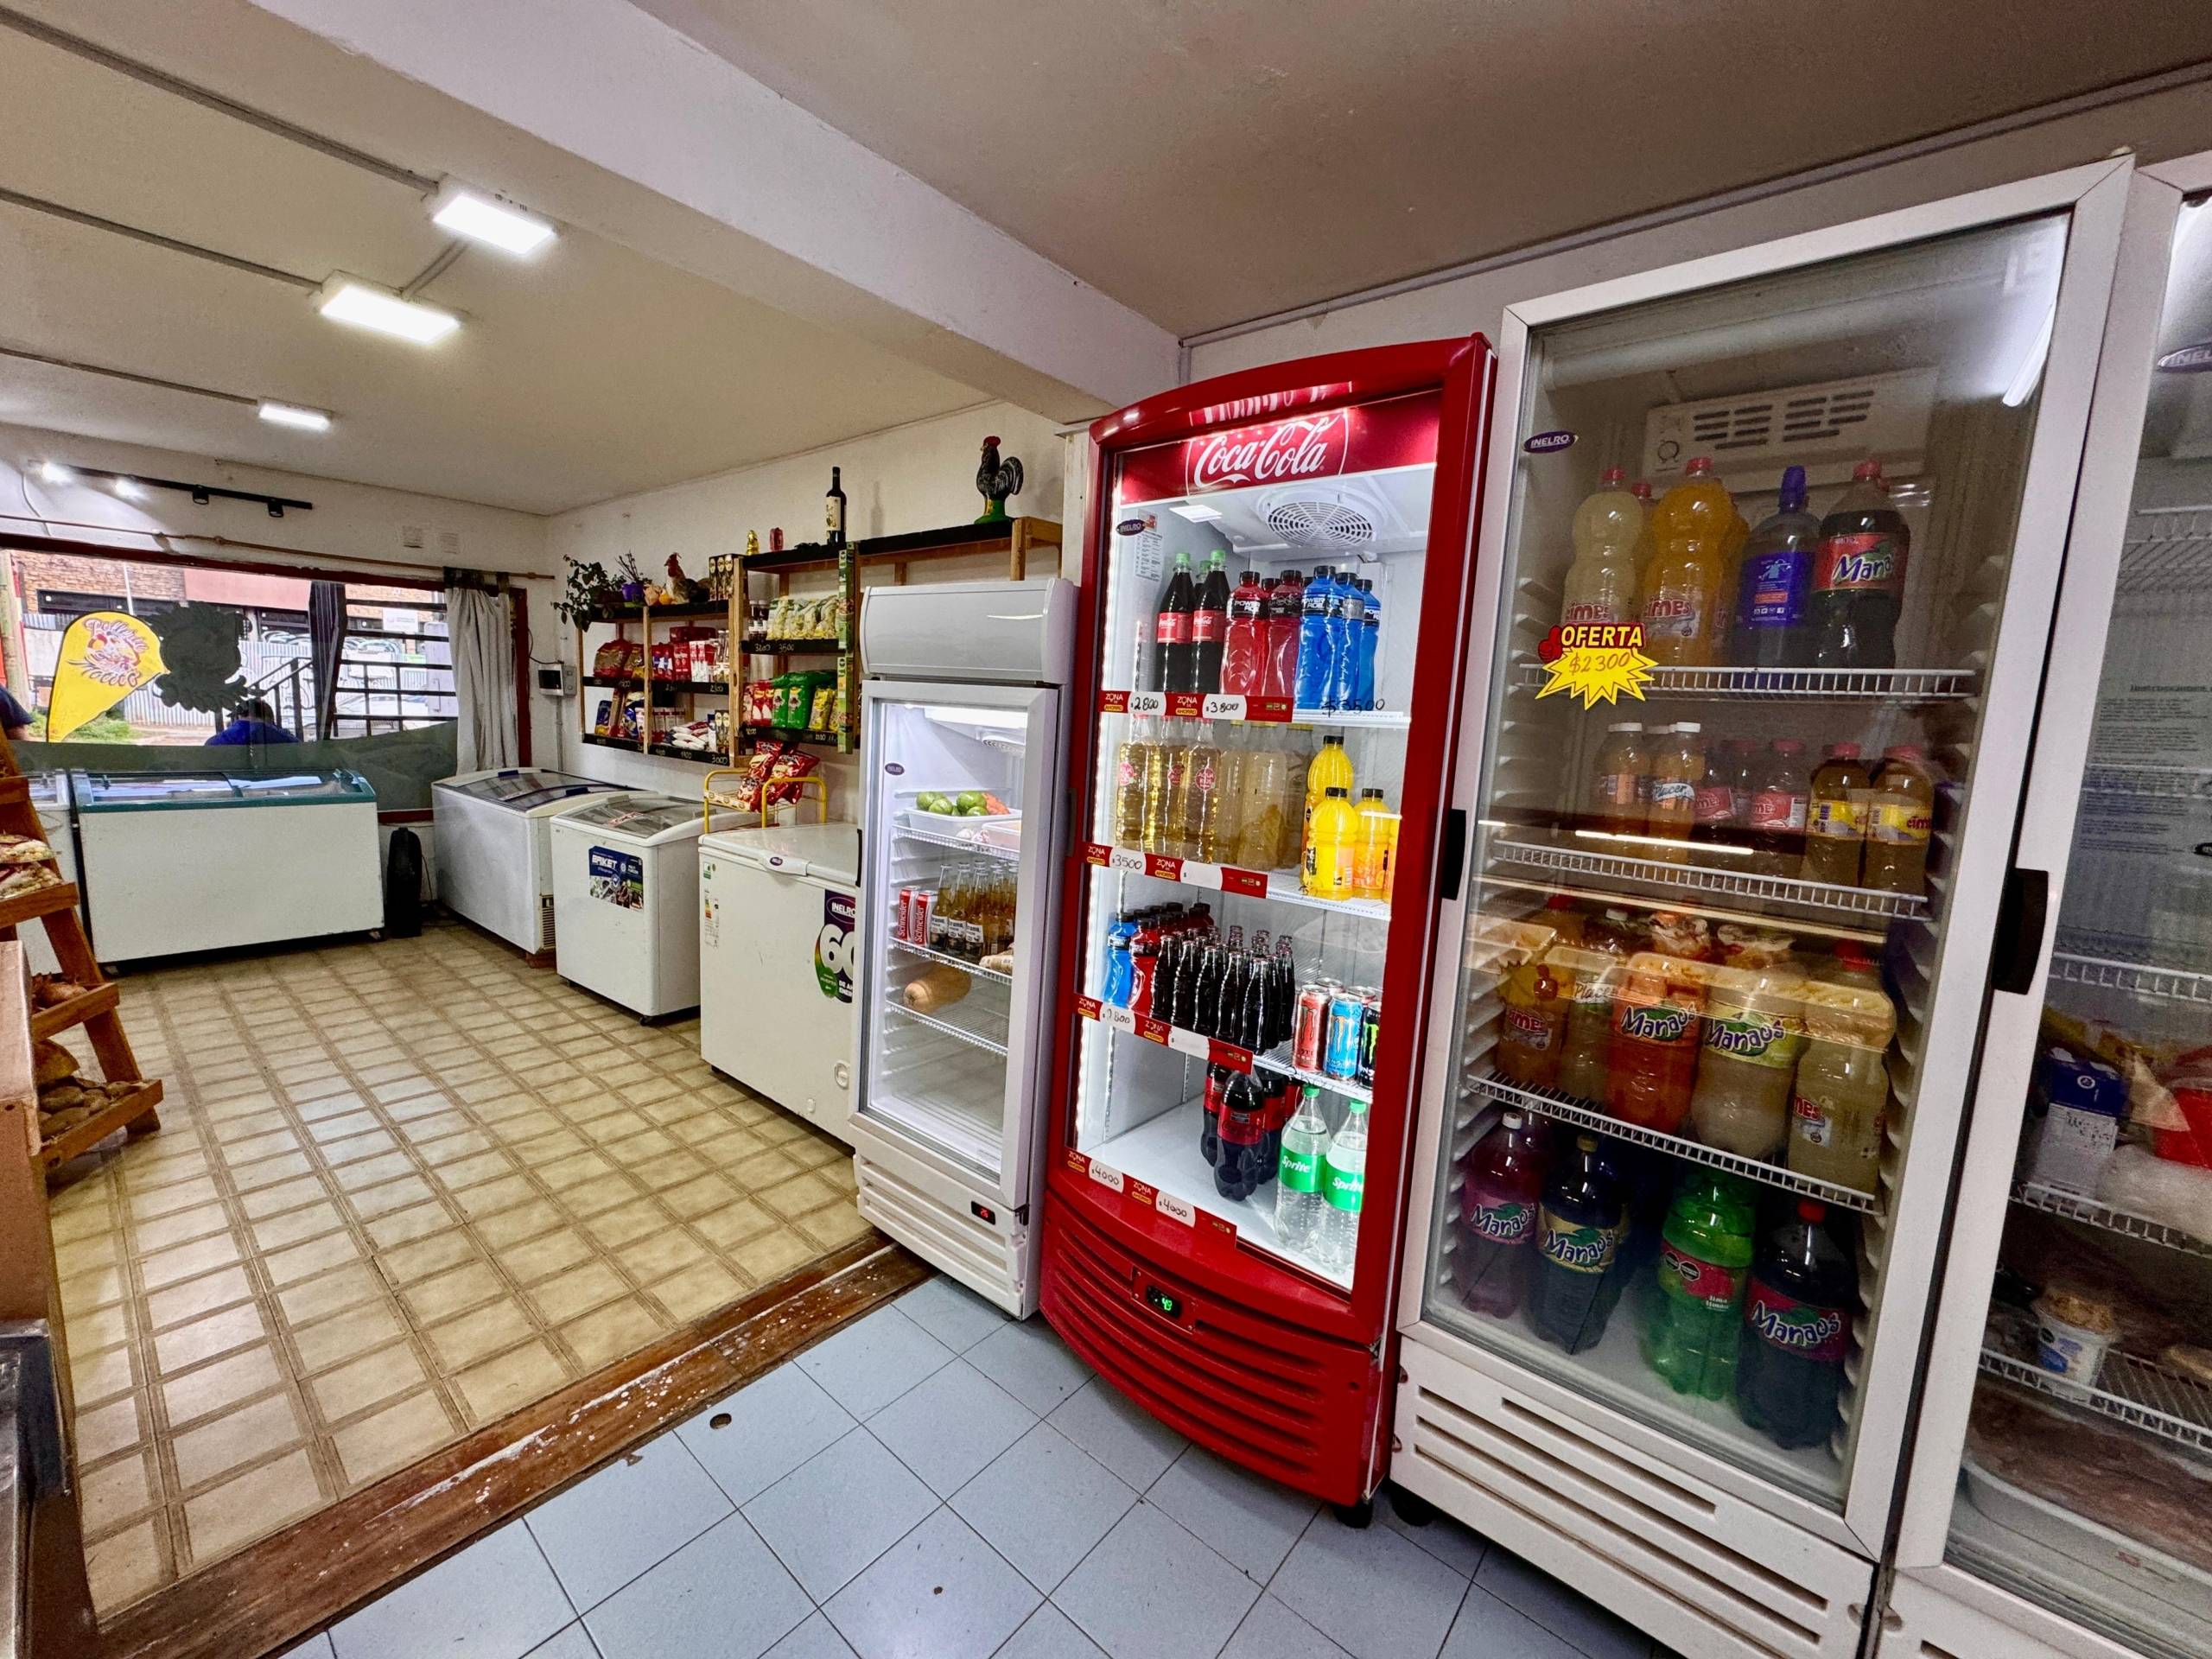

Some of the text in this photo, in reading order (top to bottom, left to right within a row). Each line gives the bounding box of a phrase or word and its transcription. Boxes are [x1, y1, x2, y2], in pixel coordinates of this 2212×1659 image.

[2170, 348, 2212, 367] INEL
[1193, 414, 1339, 488] Coca-Cola
[1530, 434, 1570, 448] INELRO
[1832, 553, 1894, 583] Mana
[1560, 626, 1643, 647] OFERTA
[1569, 652, 1630, 676] $2300
[1105, 693, 1123, 702] ZONA
[1177, 696, 1198, 705] ZONA
[1088, 846, 1105, 855] ZONA
[1156, 858, 1176, 868] ZONA
[898, 898, 907, 938] Schneider
[915, 905, 925, 943] Schneider
[1621, 1001, 1697, 1037] Manaos
[1707, 1019, 1786, 1052] Manaos
[1281, 1156, 1311, 1173] Sprite
[1134, 1181, 1152, 1195] ZONA
[1332, 1176, 1363, 1192] Sprit
[1471, 1203, 1535, 1236] Manaos
[1544, 1228, 1614, 1263] Manaos
[1751, 1300, 1841, 1347] Manaos
